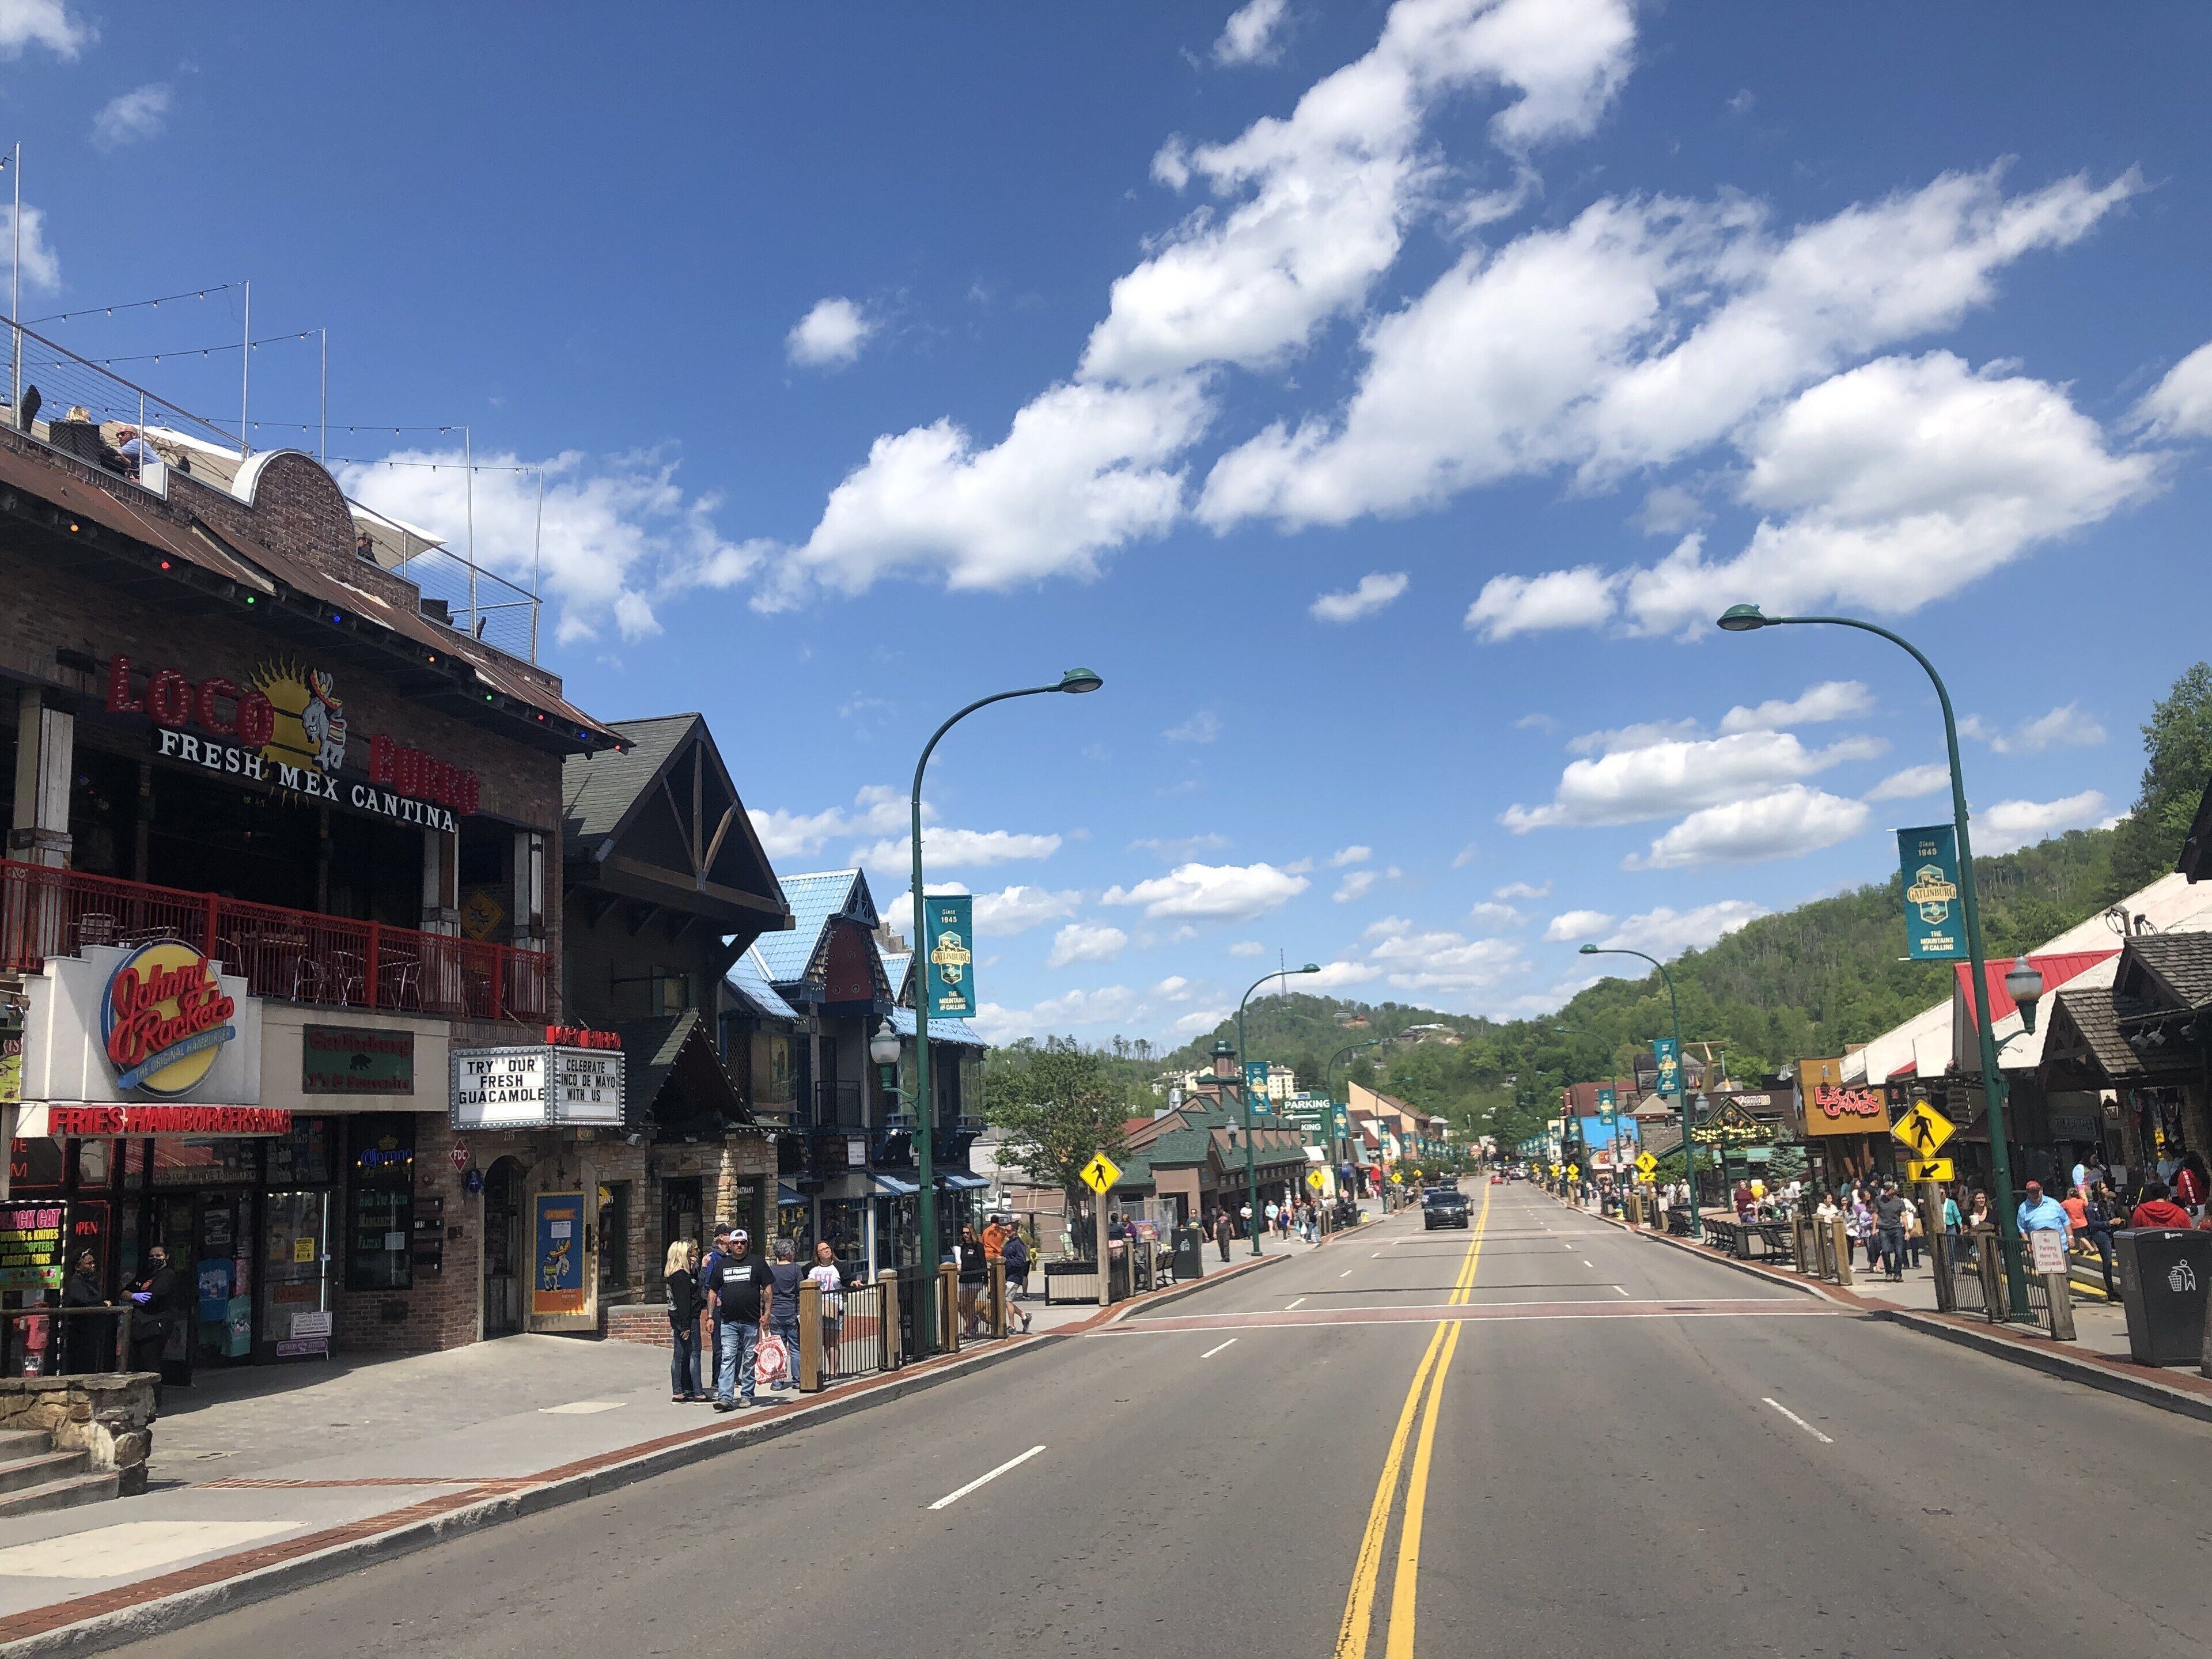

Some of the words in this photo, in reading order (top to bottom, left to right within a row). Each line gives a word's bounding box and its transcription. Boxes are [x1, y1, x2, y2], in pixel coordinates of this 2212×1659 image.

[105, 653, 275, 748] LOCO
[158, 728, 267, 781] FRESH
[278, 761, 339, 801] MEX
[352, 785, 455, 833] CANTINA
[369, 733, 479, 816] BURRO
[1918, 848, 1937, 856] 1945
[1908, 886, 1956, 900] GATLINBURG
[932, 951, 970, 963] GATLINBURG
[112, 957, 218, 1019] Johnny
[108, 990, 234, 1065] Rockets
[136, 1064, 149, 1080] THE
[150, 1047, 184, 1072] ORIGINAL
[187, 1029, 231, 1052] HAMBURGER
[467, 1060, 494, 1074] TRY
[509, 1059, 535, 1073] OUR
[566, 1059, 605, 1074] CELEBRATE
[480, 1074, 524, 1088] FRESH
[582, 1074, 591, 1087] DE
[596, 1075, 616, 1089] MAYO
[459, 1088, 544, 1104] GUACAMOLE
[567, 1088, 585, 1101] WITH
[591, 1089, 601, 1102] US
[1284, 1099, 1330, 1109] PARKING
[1824, 1093, 1880, 1116] GAMES
[49, 1107, 125, 1135] FRIES
[128, 1106, 256, 1133] HAMBURGERS
[503, 1131, 516, 1142] 735
[453, 1149, 467, 1160] FDC
[37, 1209, 61, 1229] CAT
[27, 1232, 32, 1241] &
[33, 1229, 59, 1240] KNIVES
[31, 1253, 51, 1265] GUNS
